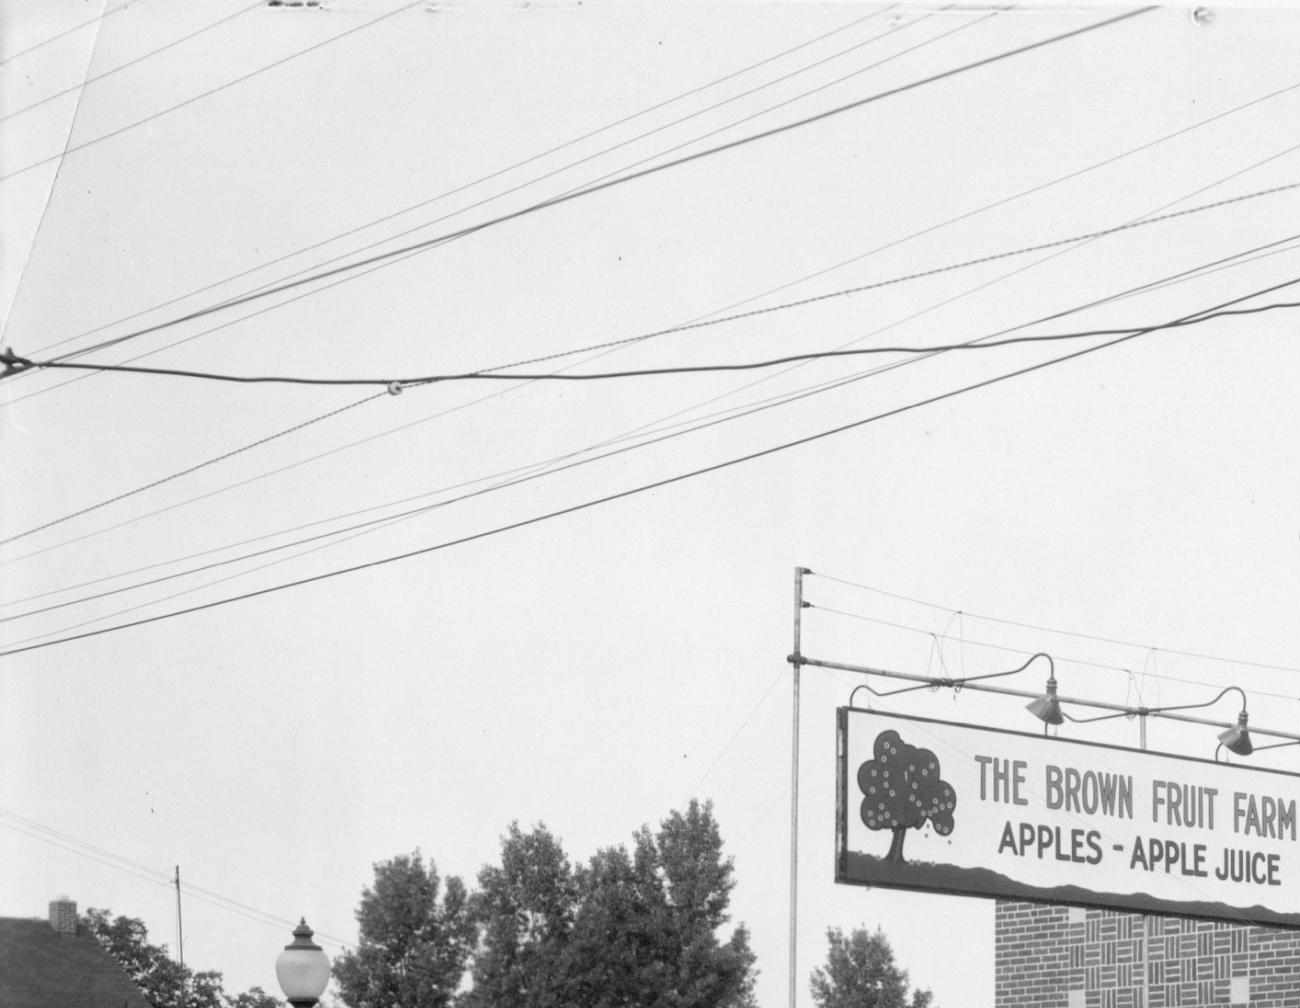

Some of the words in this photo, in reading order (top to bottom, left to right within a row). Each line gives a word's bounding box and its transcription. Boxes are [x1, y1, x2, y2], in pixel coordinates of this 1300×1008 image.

[974, 755, 1029, 806] THE
[1045, 765, 1134, 820] BROWN
[1151, 780, 1218, 830] FRUIT
[1232, 791, 1298, 841] FARM
[998, 821, 1103, 865] APPLES
[1130, 836, 1208, 878] APPLE
[1215, 847, 1282, 886] JUICE
